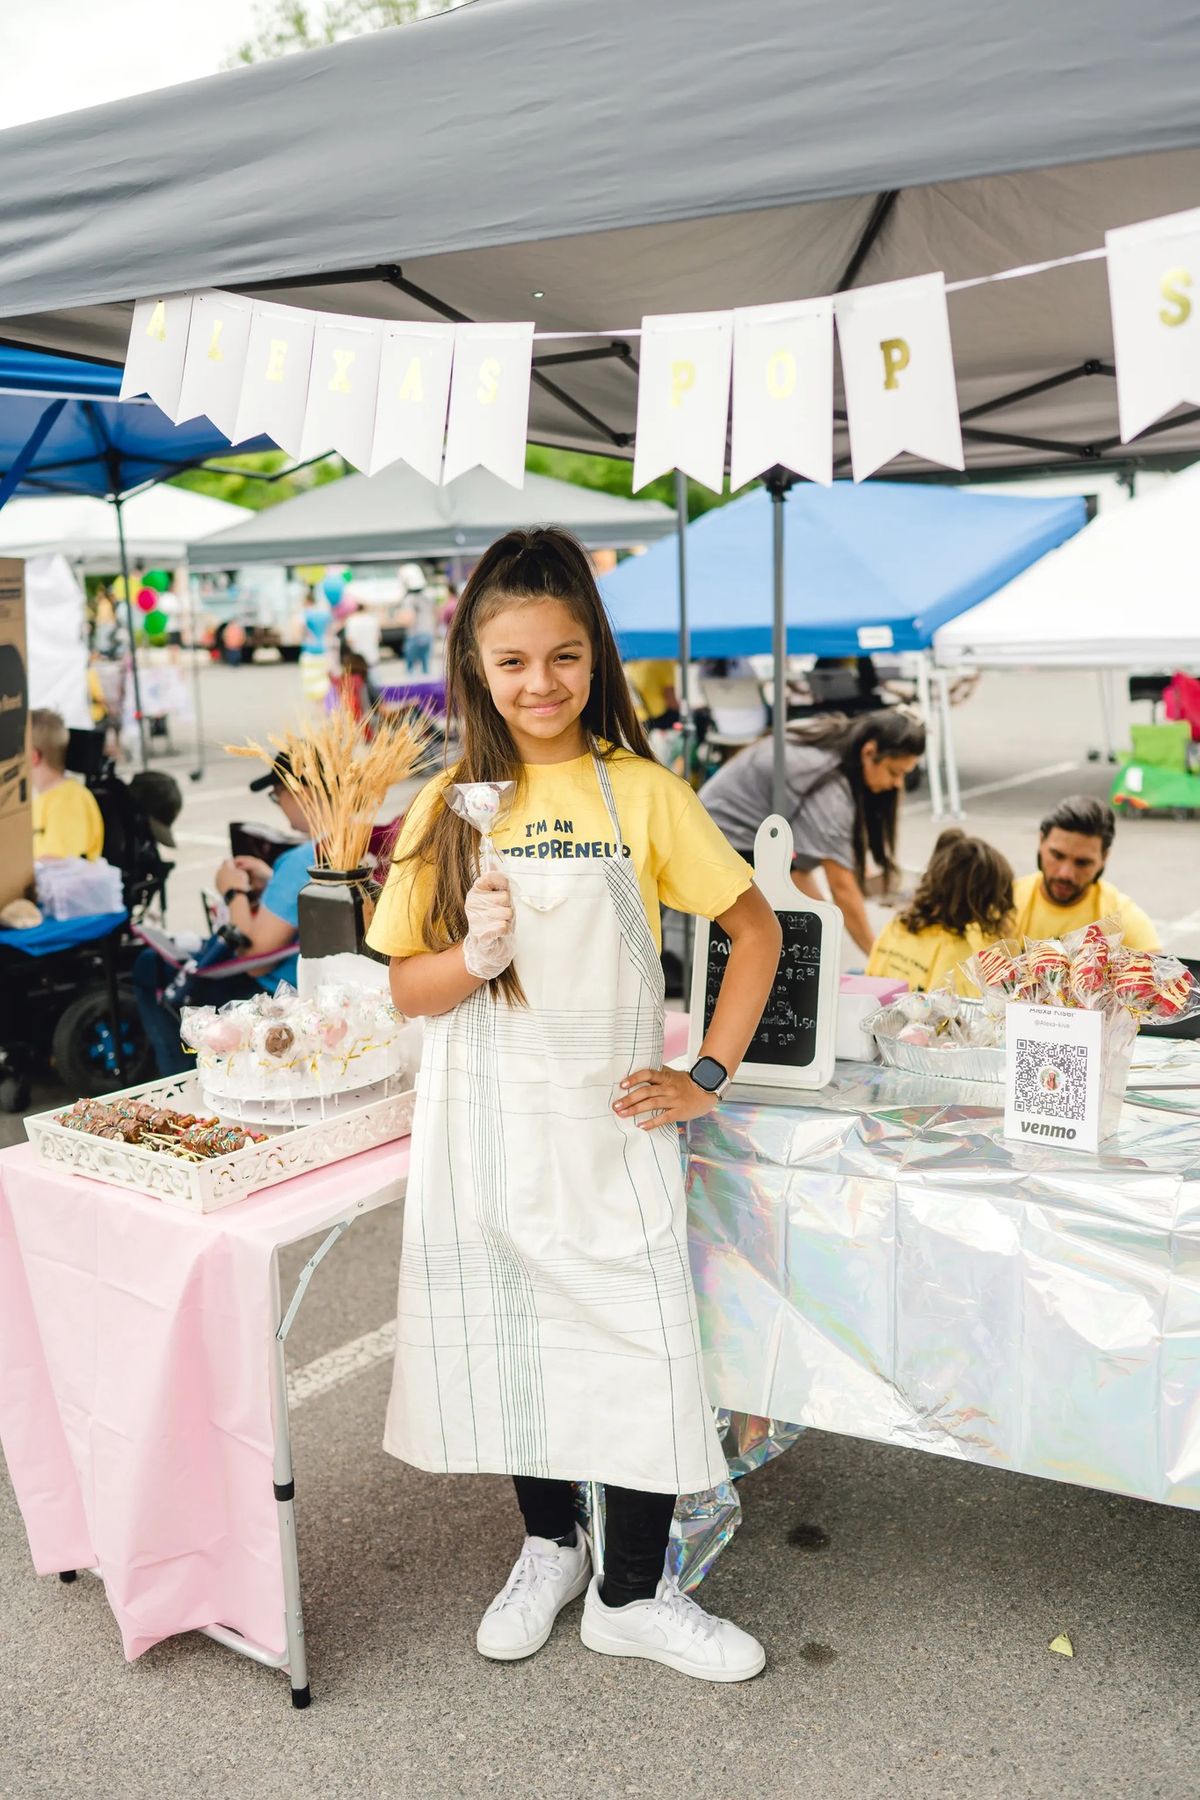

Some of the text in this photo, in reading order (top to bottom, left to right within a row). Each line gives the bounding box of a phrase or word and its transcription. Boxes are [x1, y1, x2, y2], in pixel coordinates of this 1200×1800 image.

[525, 818, 574, 838] I'M AN
[1020, 1121, 1077, 1140] venmo
